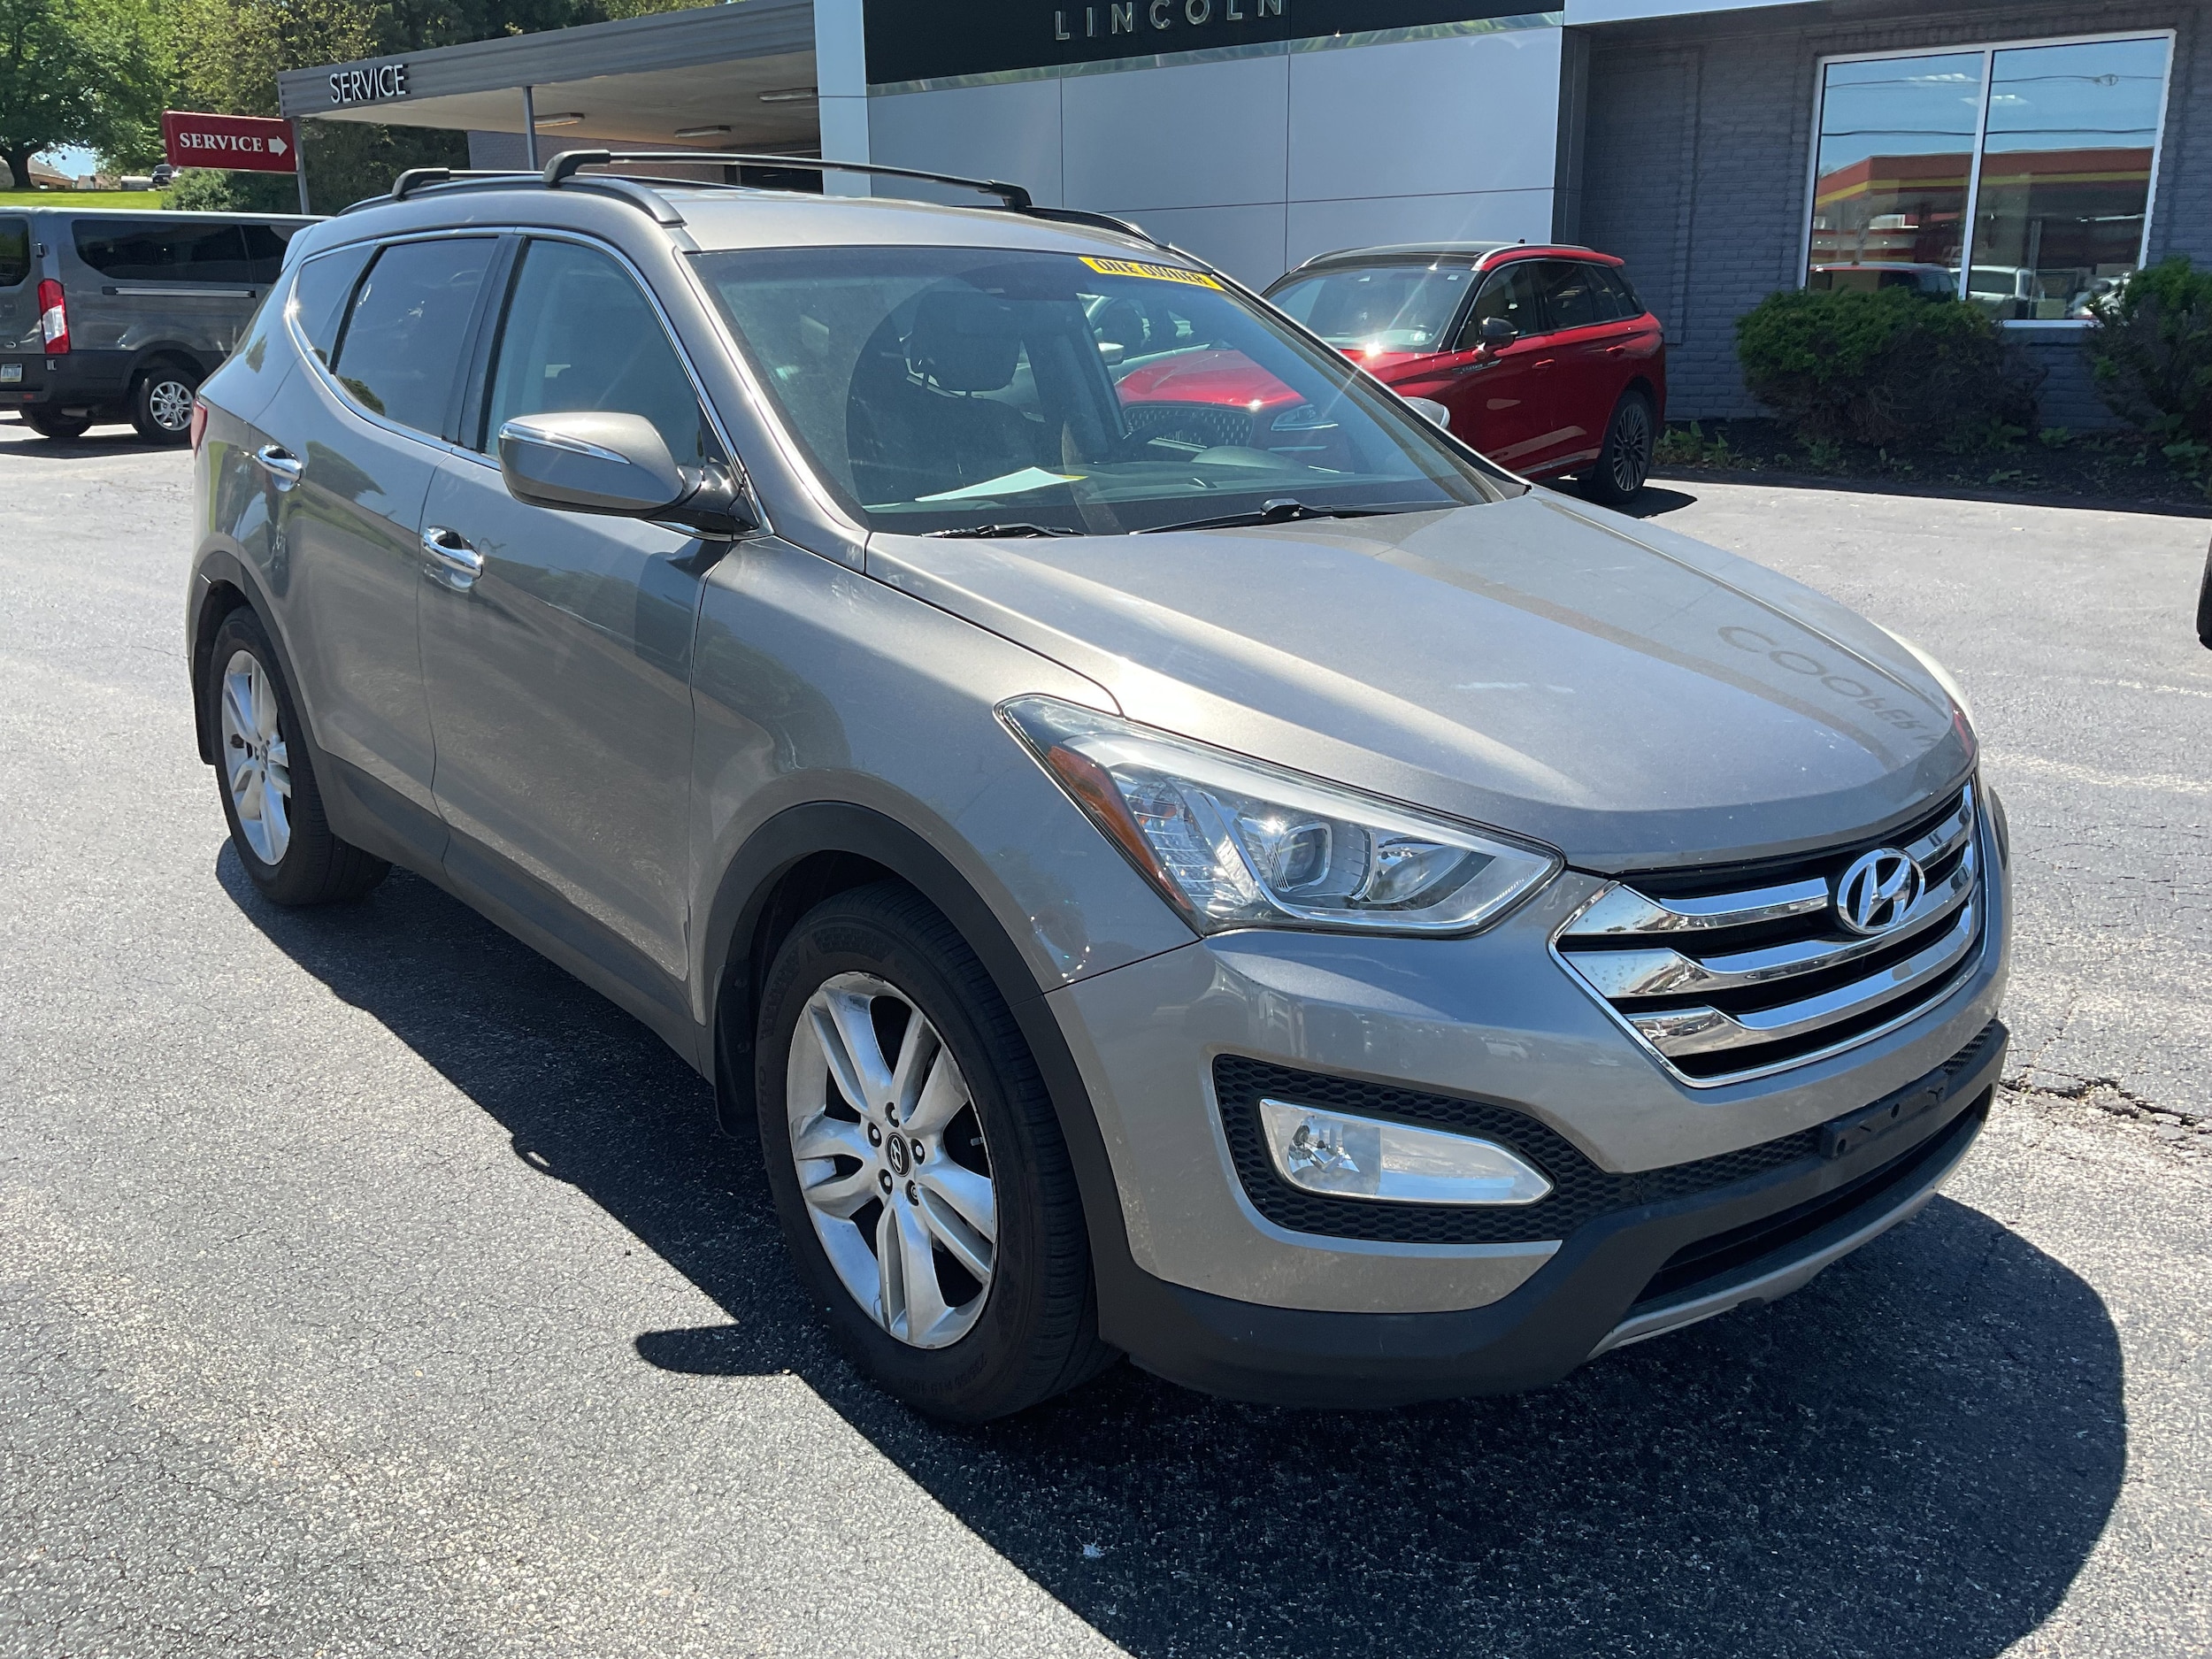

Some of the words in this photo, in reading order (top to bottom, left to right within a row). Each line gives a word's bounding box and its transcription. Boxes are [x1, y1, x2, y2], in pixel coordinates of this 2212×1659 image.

[1055, 0, 1282, 41] LINCOLN
[329, 64, 407, 104] SERVICE
[179, 132, 264, 153] SERVICE
[1094, 259, 1138, 273] ONE
[1141, 265, 1210, 285] OWNER
